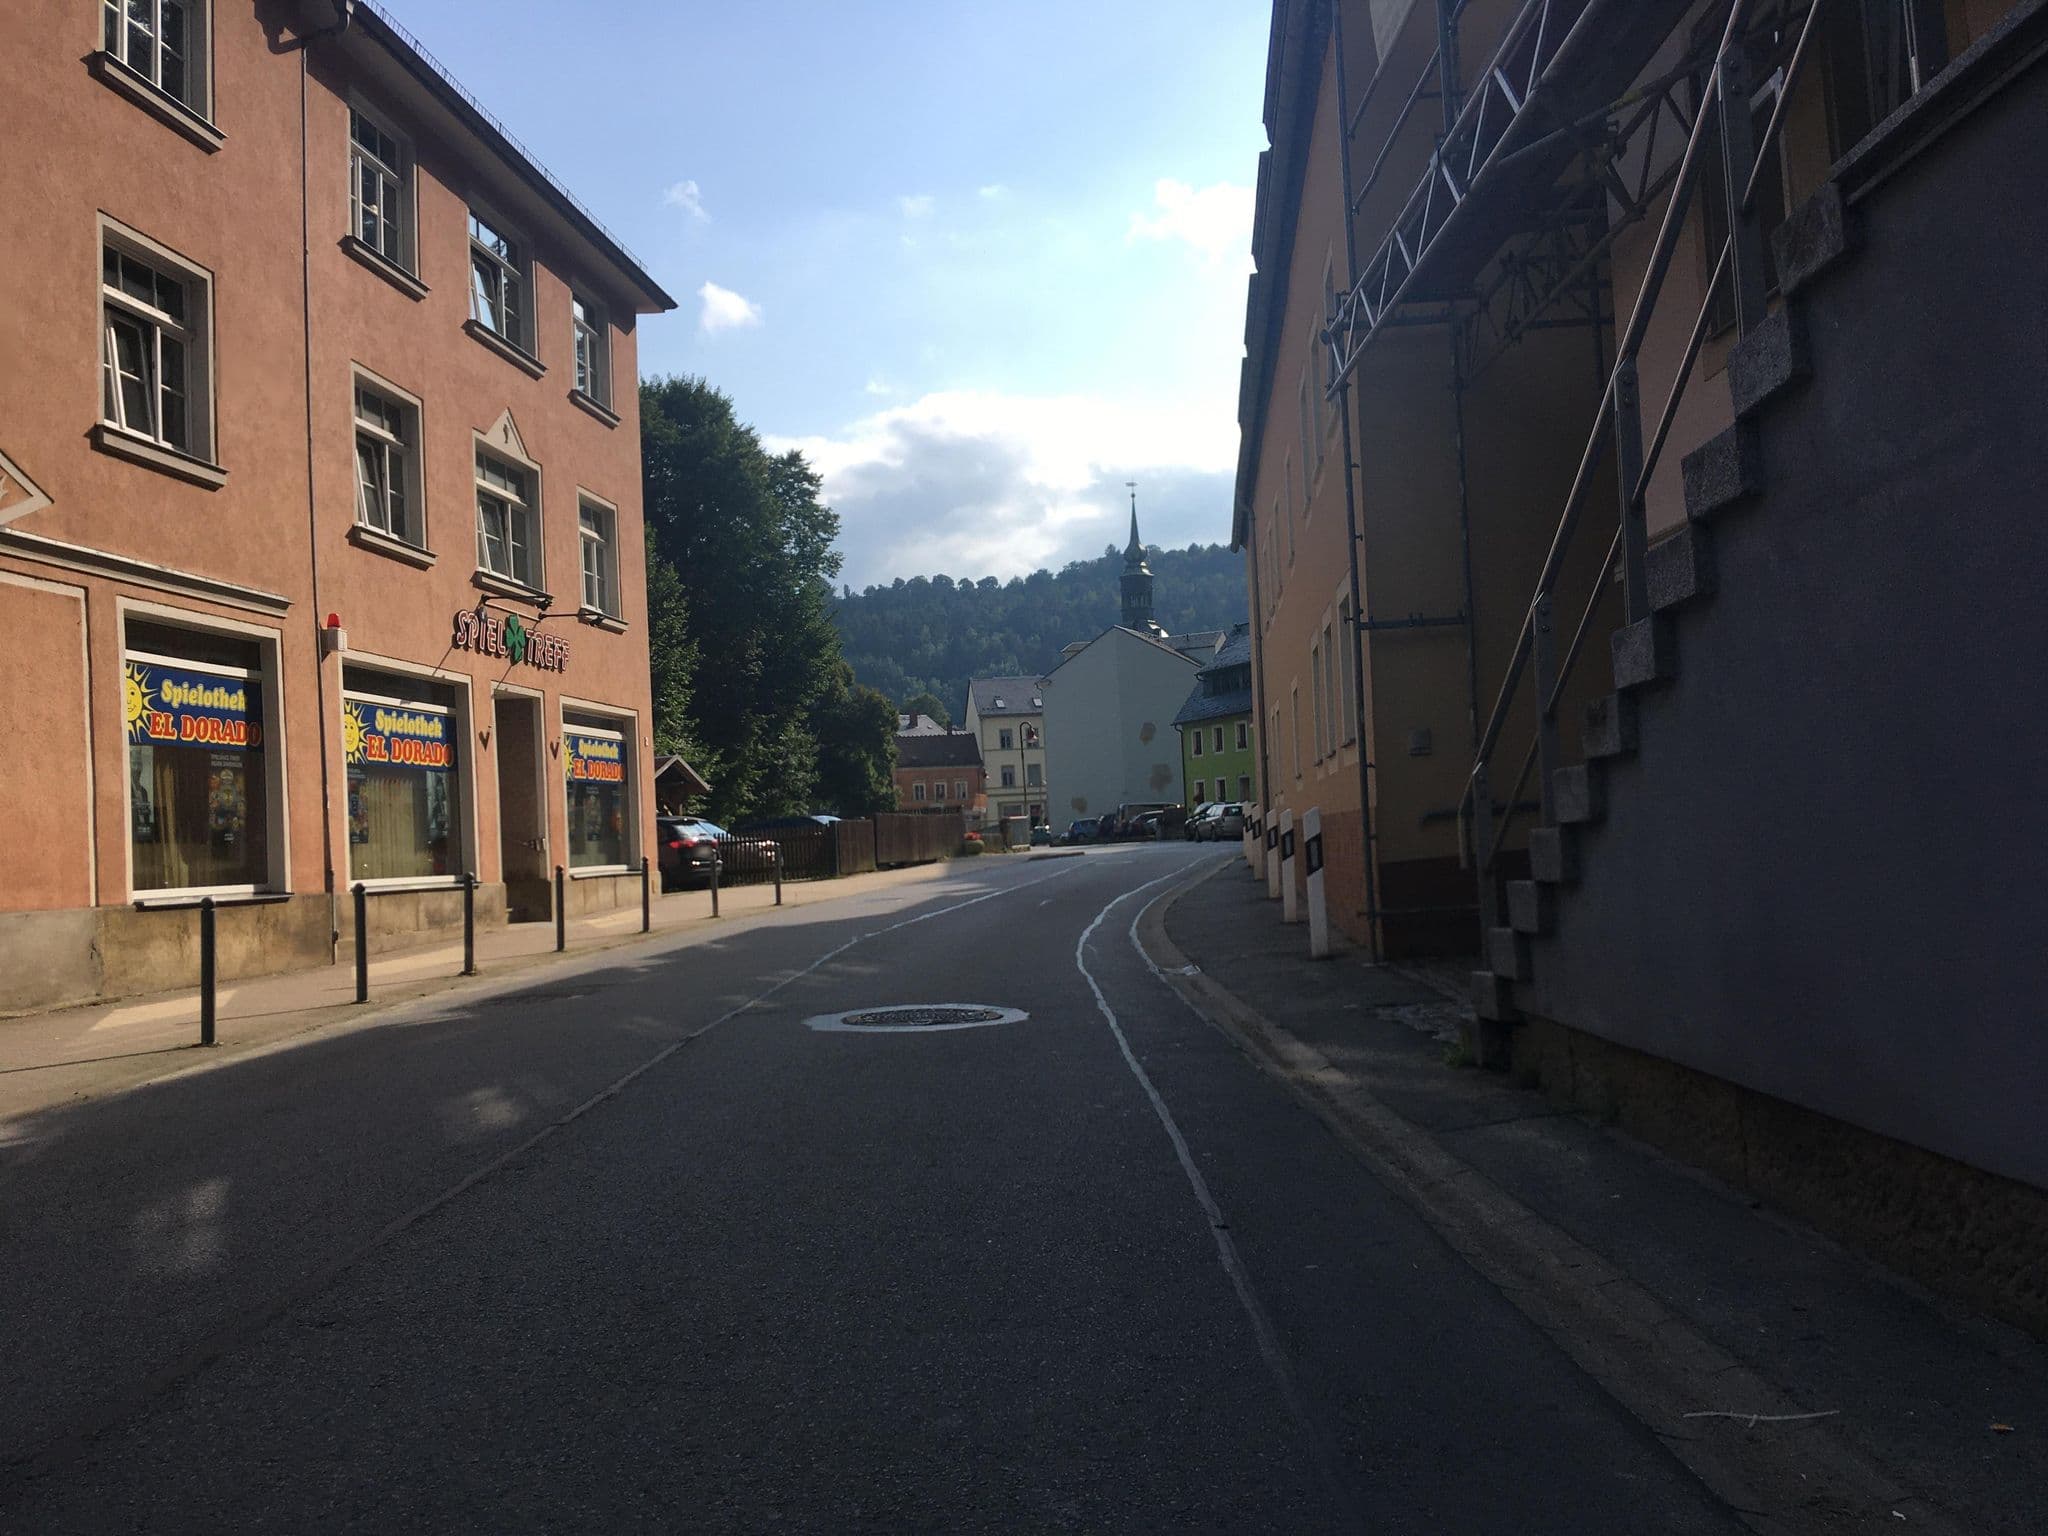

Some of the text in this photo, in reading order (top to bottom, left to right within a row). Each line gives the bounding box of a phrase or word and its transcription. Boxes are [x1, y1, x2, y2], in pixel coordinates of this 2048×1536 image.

[456, 610, 569, 671] SPIEL TREFF
[161, 679, 246, 712] Spielothek
[150, 711, 260, 746] EL DORADO
[375, 708, 442, 738] Spielothek
[366, 734, 454, 767] EL DORADO
[579, 738, 619, 759] Spielothek
[574, 758, 624, 782] EL DORADO
